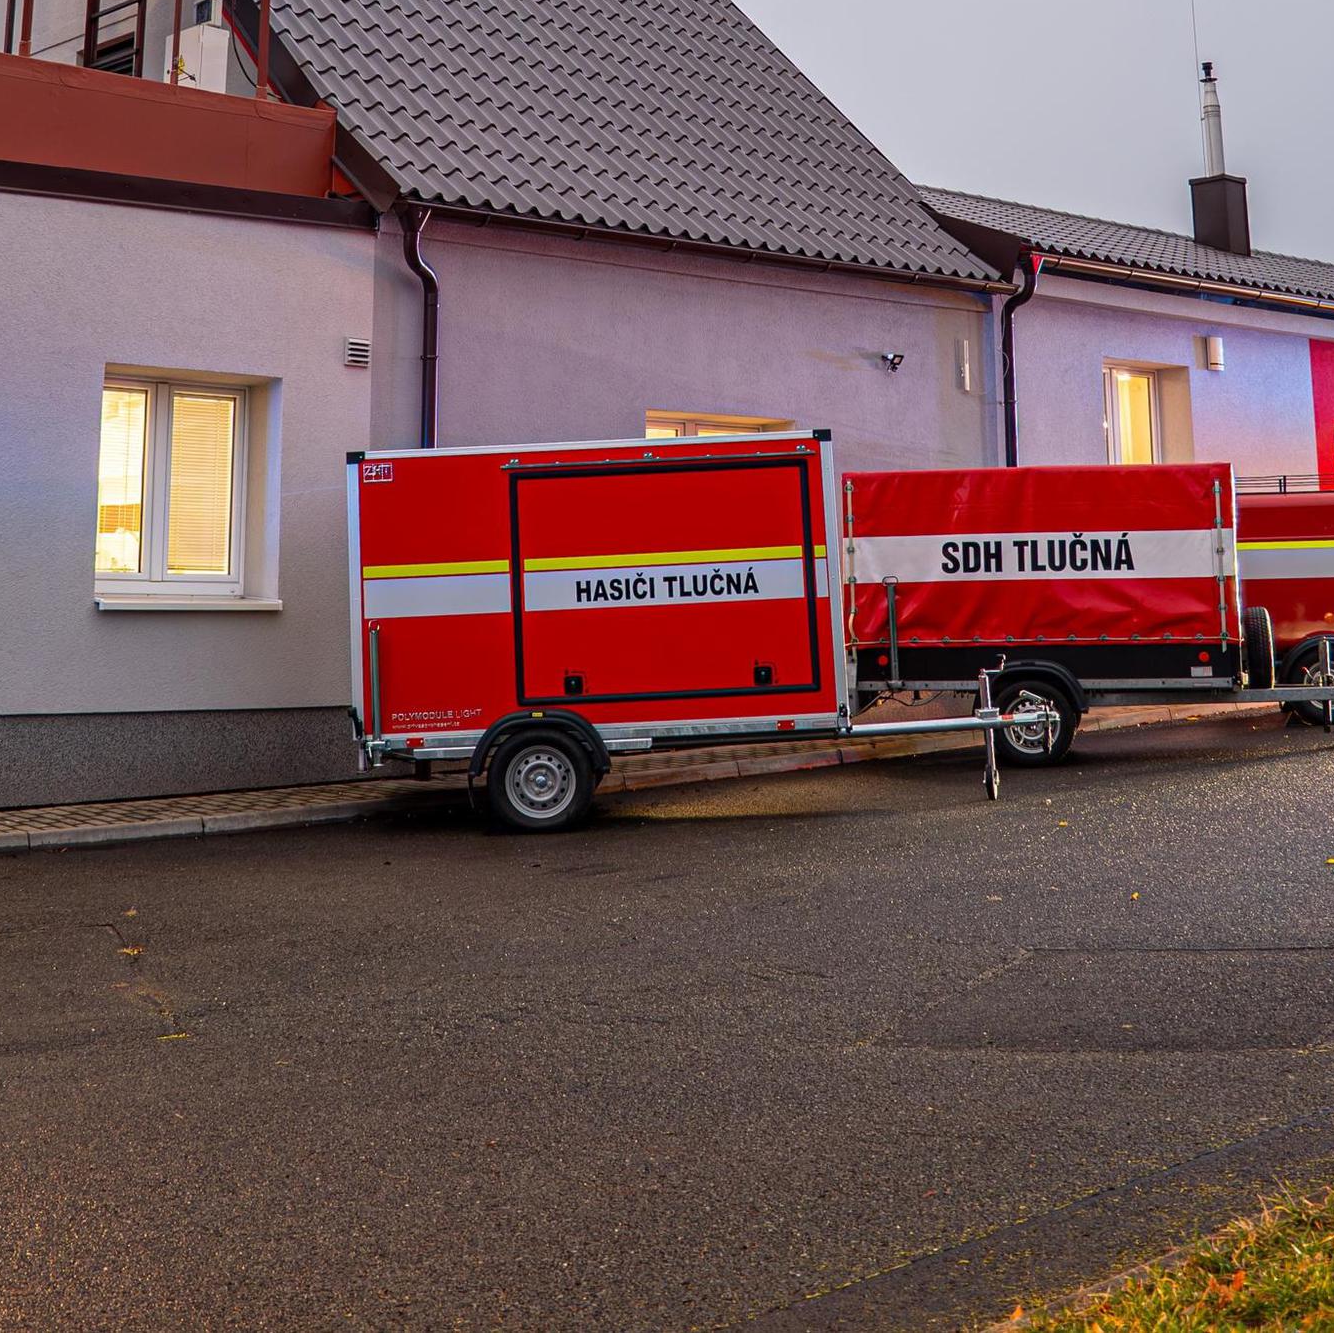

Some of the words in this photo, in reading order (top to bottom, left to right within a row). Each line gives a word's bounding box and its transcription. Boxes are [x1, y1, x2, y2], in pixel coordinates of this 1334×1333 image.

[941, 540, 1003, 574] SDH
[1012, 533, 1135, 572] TLUČNÁ
[575, 572, 656, 603] HASIČI
[662, 567, 759, 598] TLUČNÁ
[391, 710, 454, 722] POLYMODULE
[455, 708, 482, 719] LIGHT
